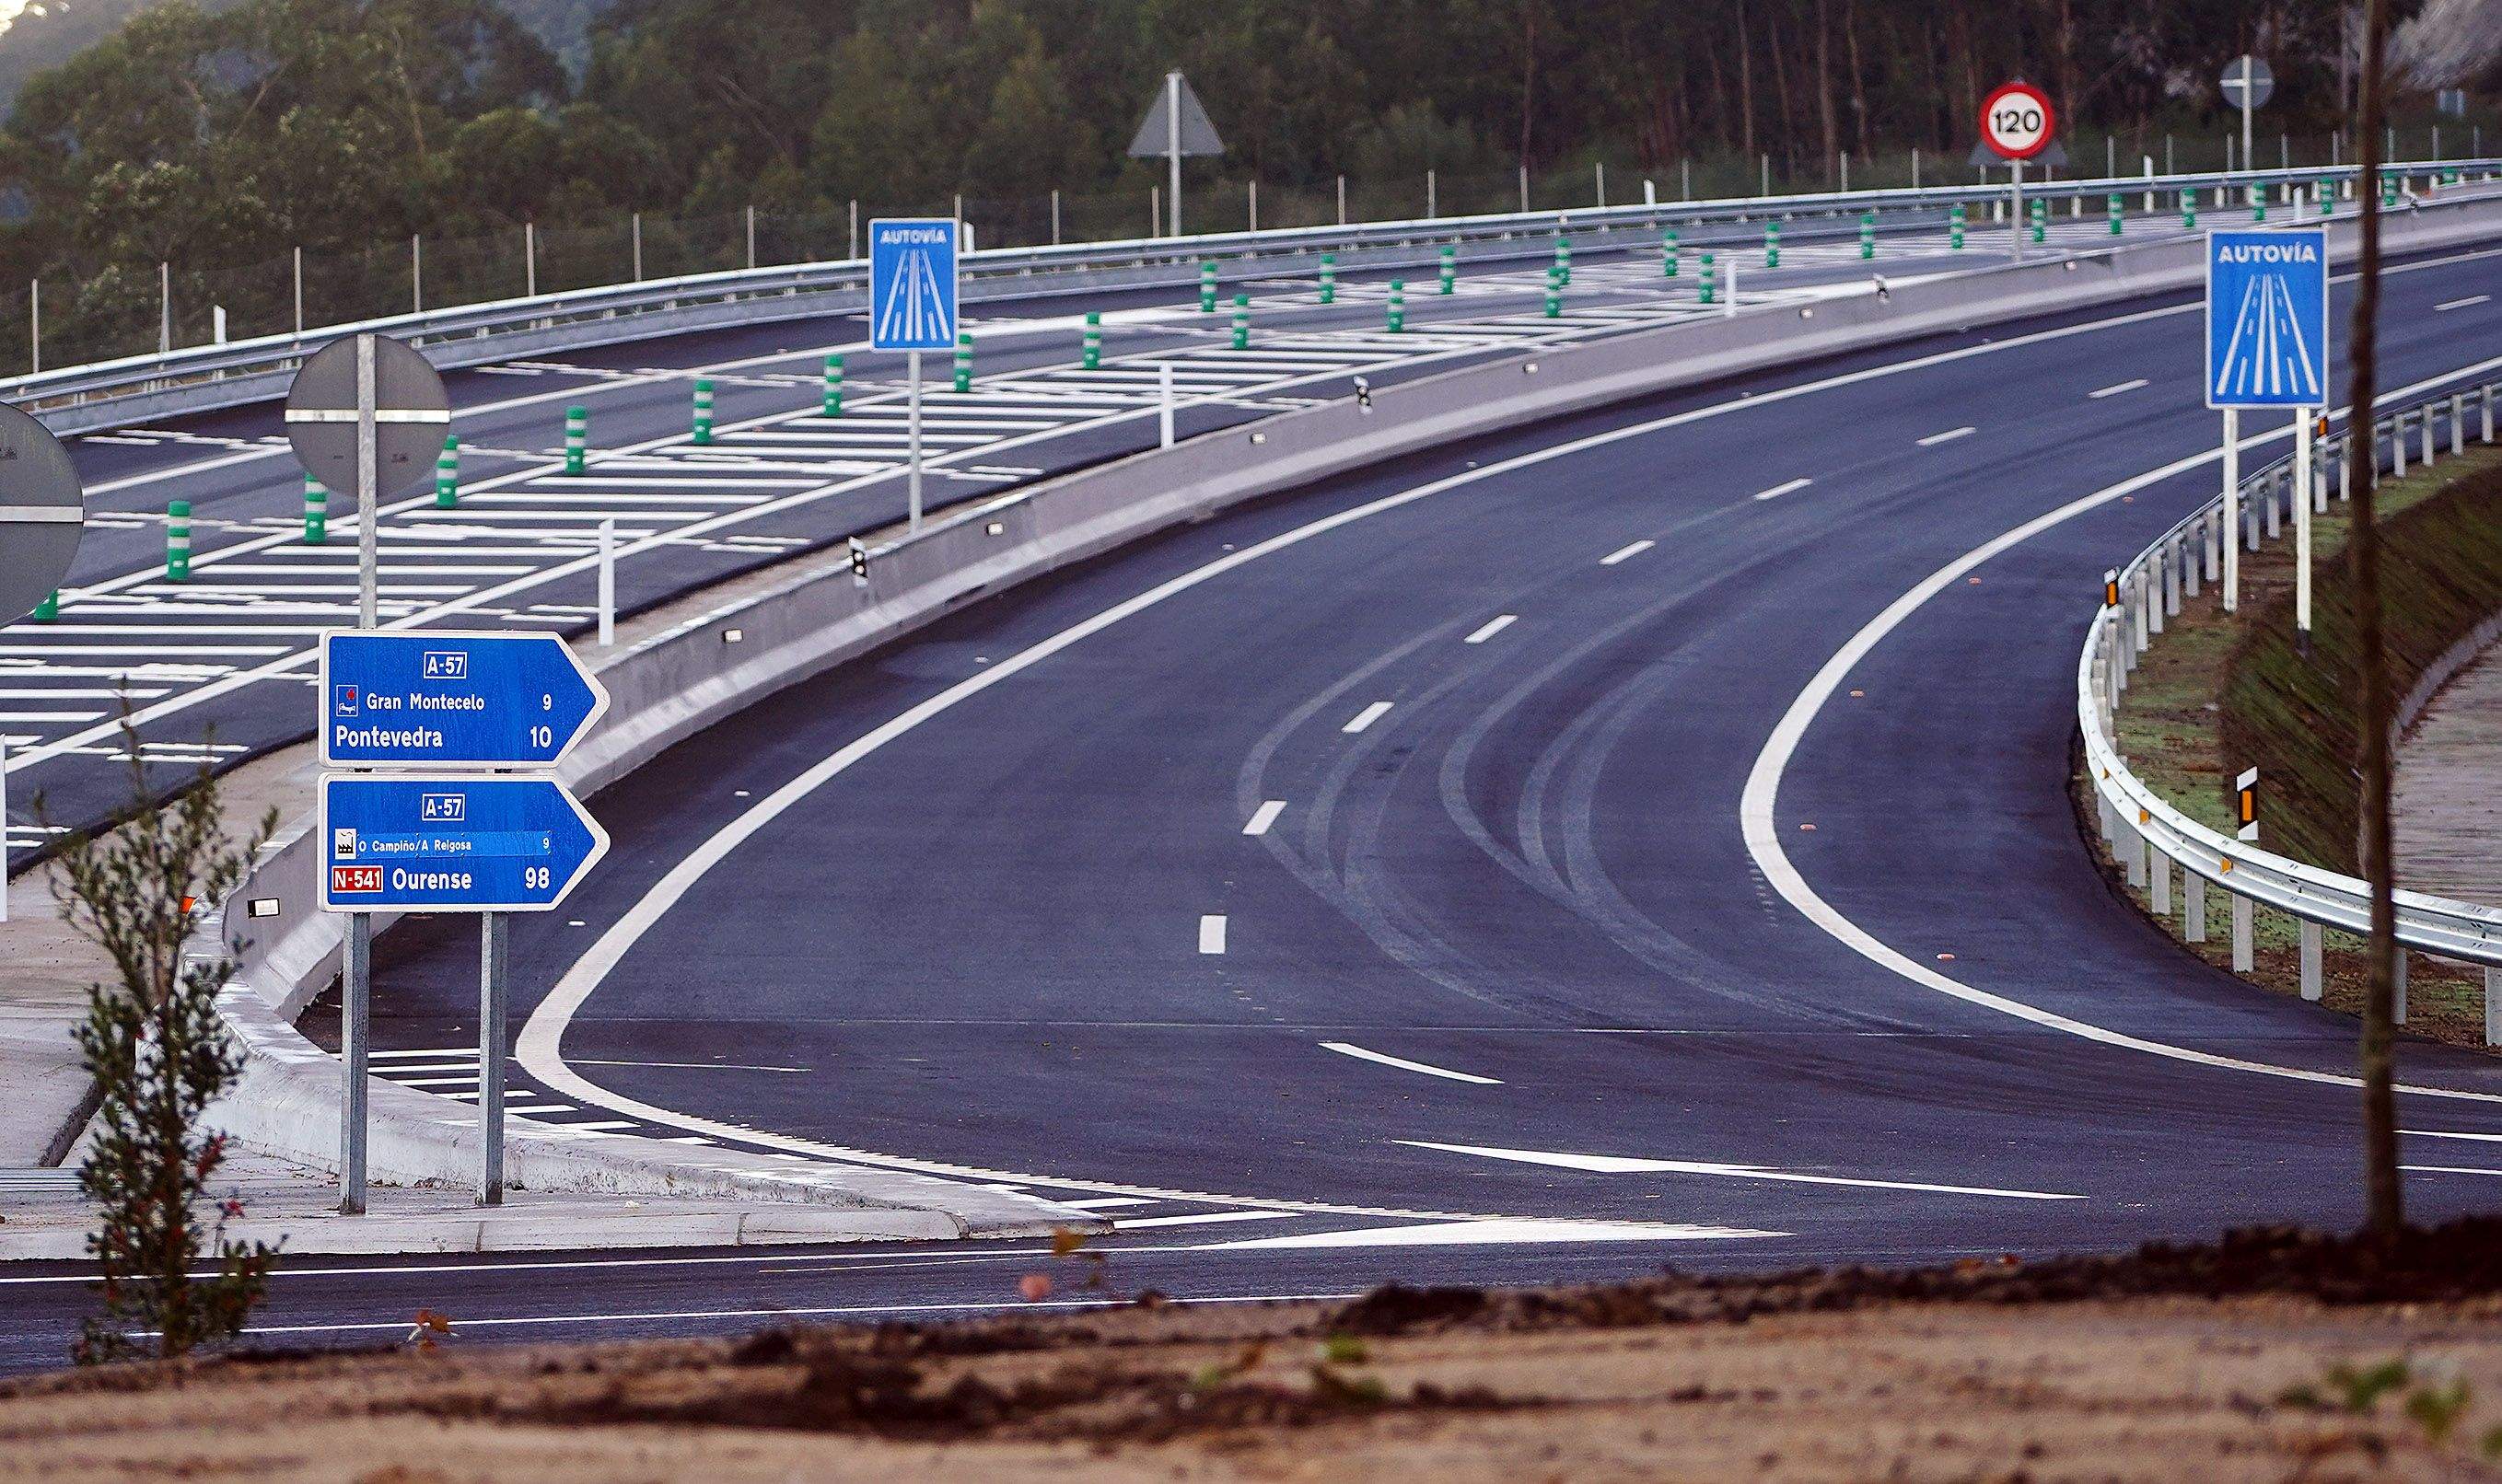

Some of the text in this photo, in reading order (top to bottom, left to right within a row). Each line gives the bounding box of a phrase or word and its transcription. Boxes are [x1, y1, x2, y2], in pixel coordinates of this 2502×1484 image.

[1995, 110, 2041, 133] 120
[2217, 241, 2317, 263] AUTOVÍA
[426, 655, 465, 675] A-57
[367, 692, 553, 712] Gran Montecelo 9
[335, 725, 553, 748] Pontevedra 10
[425, 798, 463, 817] A-57
[358, 840, 367, 852] O
[542, 837, 550, 850] 9
[333, 866, 550, 890] N-541 Ourense 98
